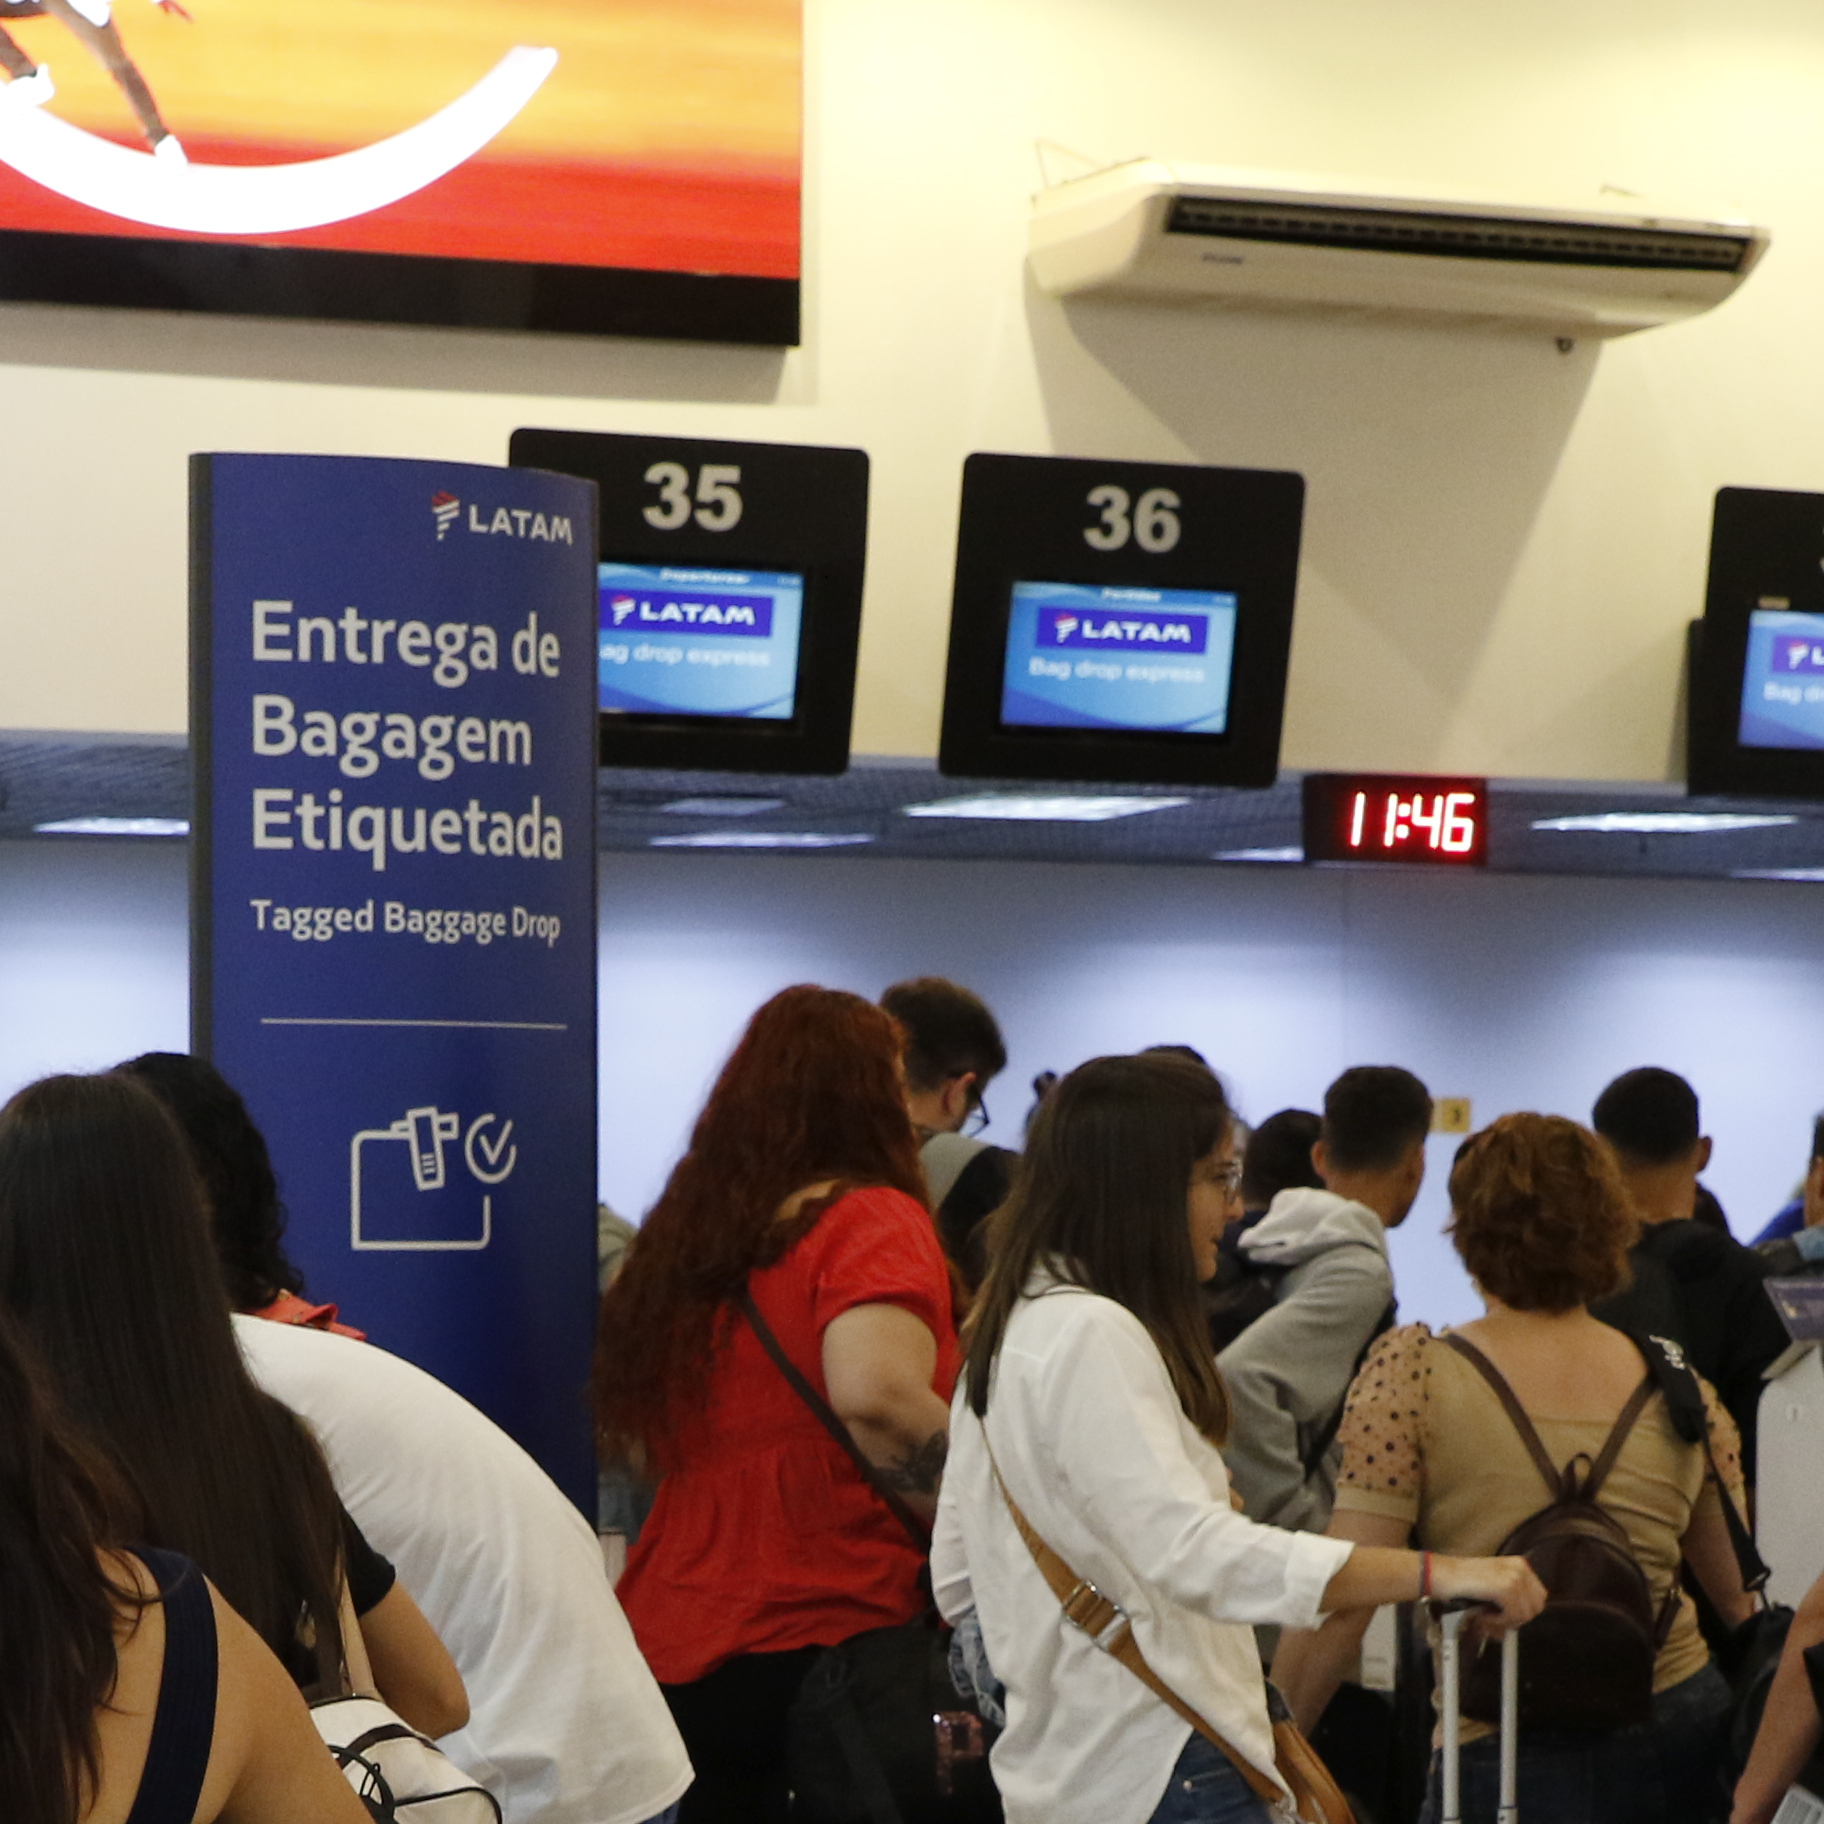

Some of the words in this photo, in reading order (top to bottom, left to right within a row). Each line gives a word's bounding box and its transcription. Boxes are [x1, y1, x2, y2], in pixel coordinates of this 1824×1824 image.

[468, 503, 573, 545] LATAM
[642, 462, 743, 532] 35
[1083, 485, 1181, 553] 36
[639, 600, 756, 627] LATAM
[1081, 619, 1192, 644] LATAM
[251, 599, 499, 688] Entrega
[511, 611, 560, 678] de
[599, 643, 629, 665] ag
[632, 643, 684, 666] drop
[1028, 657, 1072, 681] Bag
[1075, 660, 1123, 681] drop
[252, 693, 533, 781] Bagagem
[251, 788, 564, 872] Etiquetada
[1350, 791, 1475, 853] 11:46
[250, 898, 374, 941] Tagged
[384, 902, 506, 945] Baggage
[512, 906, 561, 947] Drop
